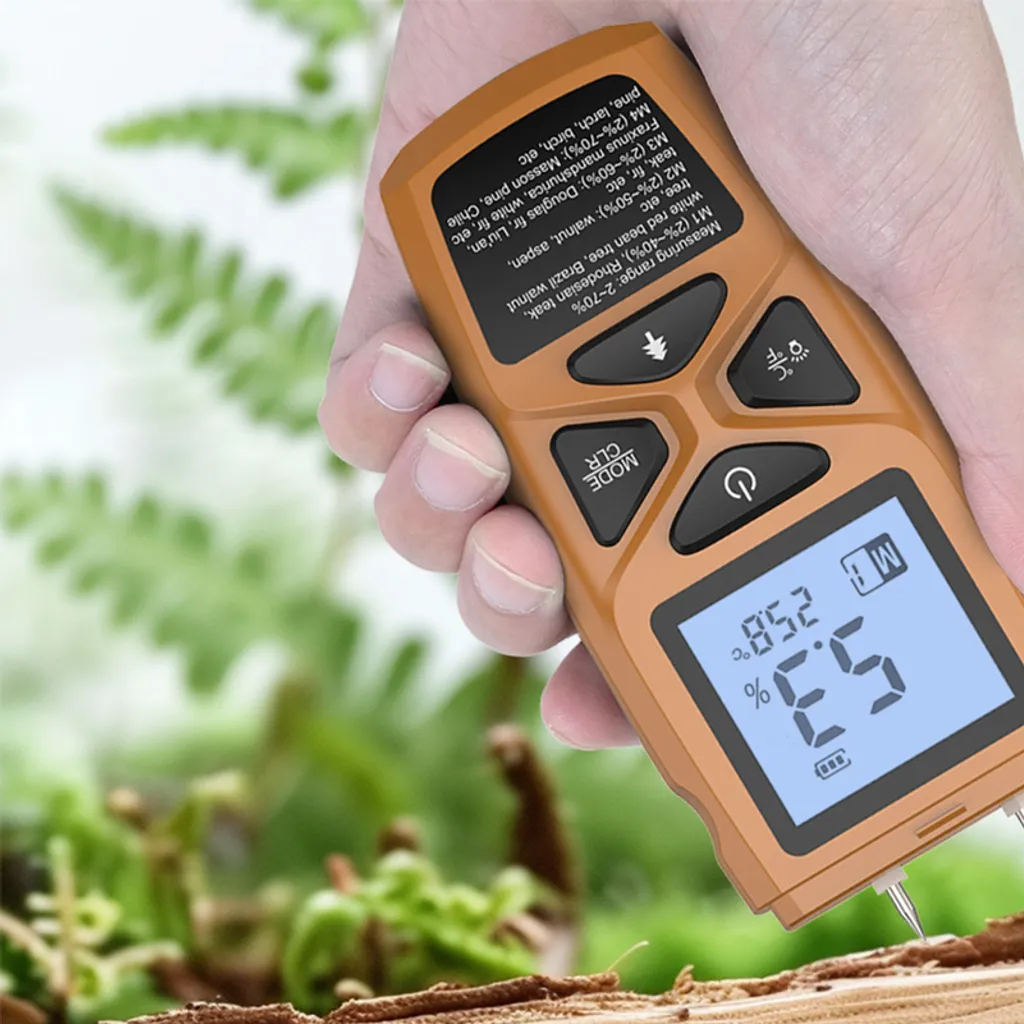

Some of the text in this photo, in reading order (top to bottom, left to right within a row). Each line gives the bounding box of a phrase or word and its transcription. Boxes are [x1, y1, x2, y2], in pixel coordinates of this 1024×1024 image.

[517, 84, 641, 166] pine, larch, birch, etc
[628, 101, 651, 122] M4
[645, 130, 669, 151] M3
[450, 116, 660, 245] Fraxinus mandshurica, white fir, etc
[510, 154, 562, 189] Masson
[604, 145, 677, 193] teak, fir, etc
[662, 160, 687, 181] M2
[478, 181, 511, 206] pine,
[525, 184, 579, 220] Douglas
[638, 176, 692, 213] tree, etc
[445, 203, 480, 228] Chile
[506, 214, 527, 229] fir,
[548, 213, 596, 245] walnut,
[690, 204, 713, 225] M1
[505, 189, 704, 313] white red bean tree, Brazil walnut
[506, 239, 550, 269] aspen,
[569, 218, 722, 315] Measuring range: 2~70%
[554, 257, 623, 302] Rhodesian
[522, 296, 557, 320] teak,
[584, 442, 621, 471] CLR
[586, 450, 640, 492] MODE
